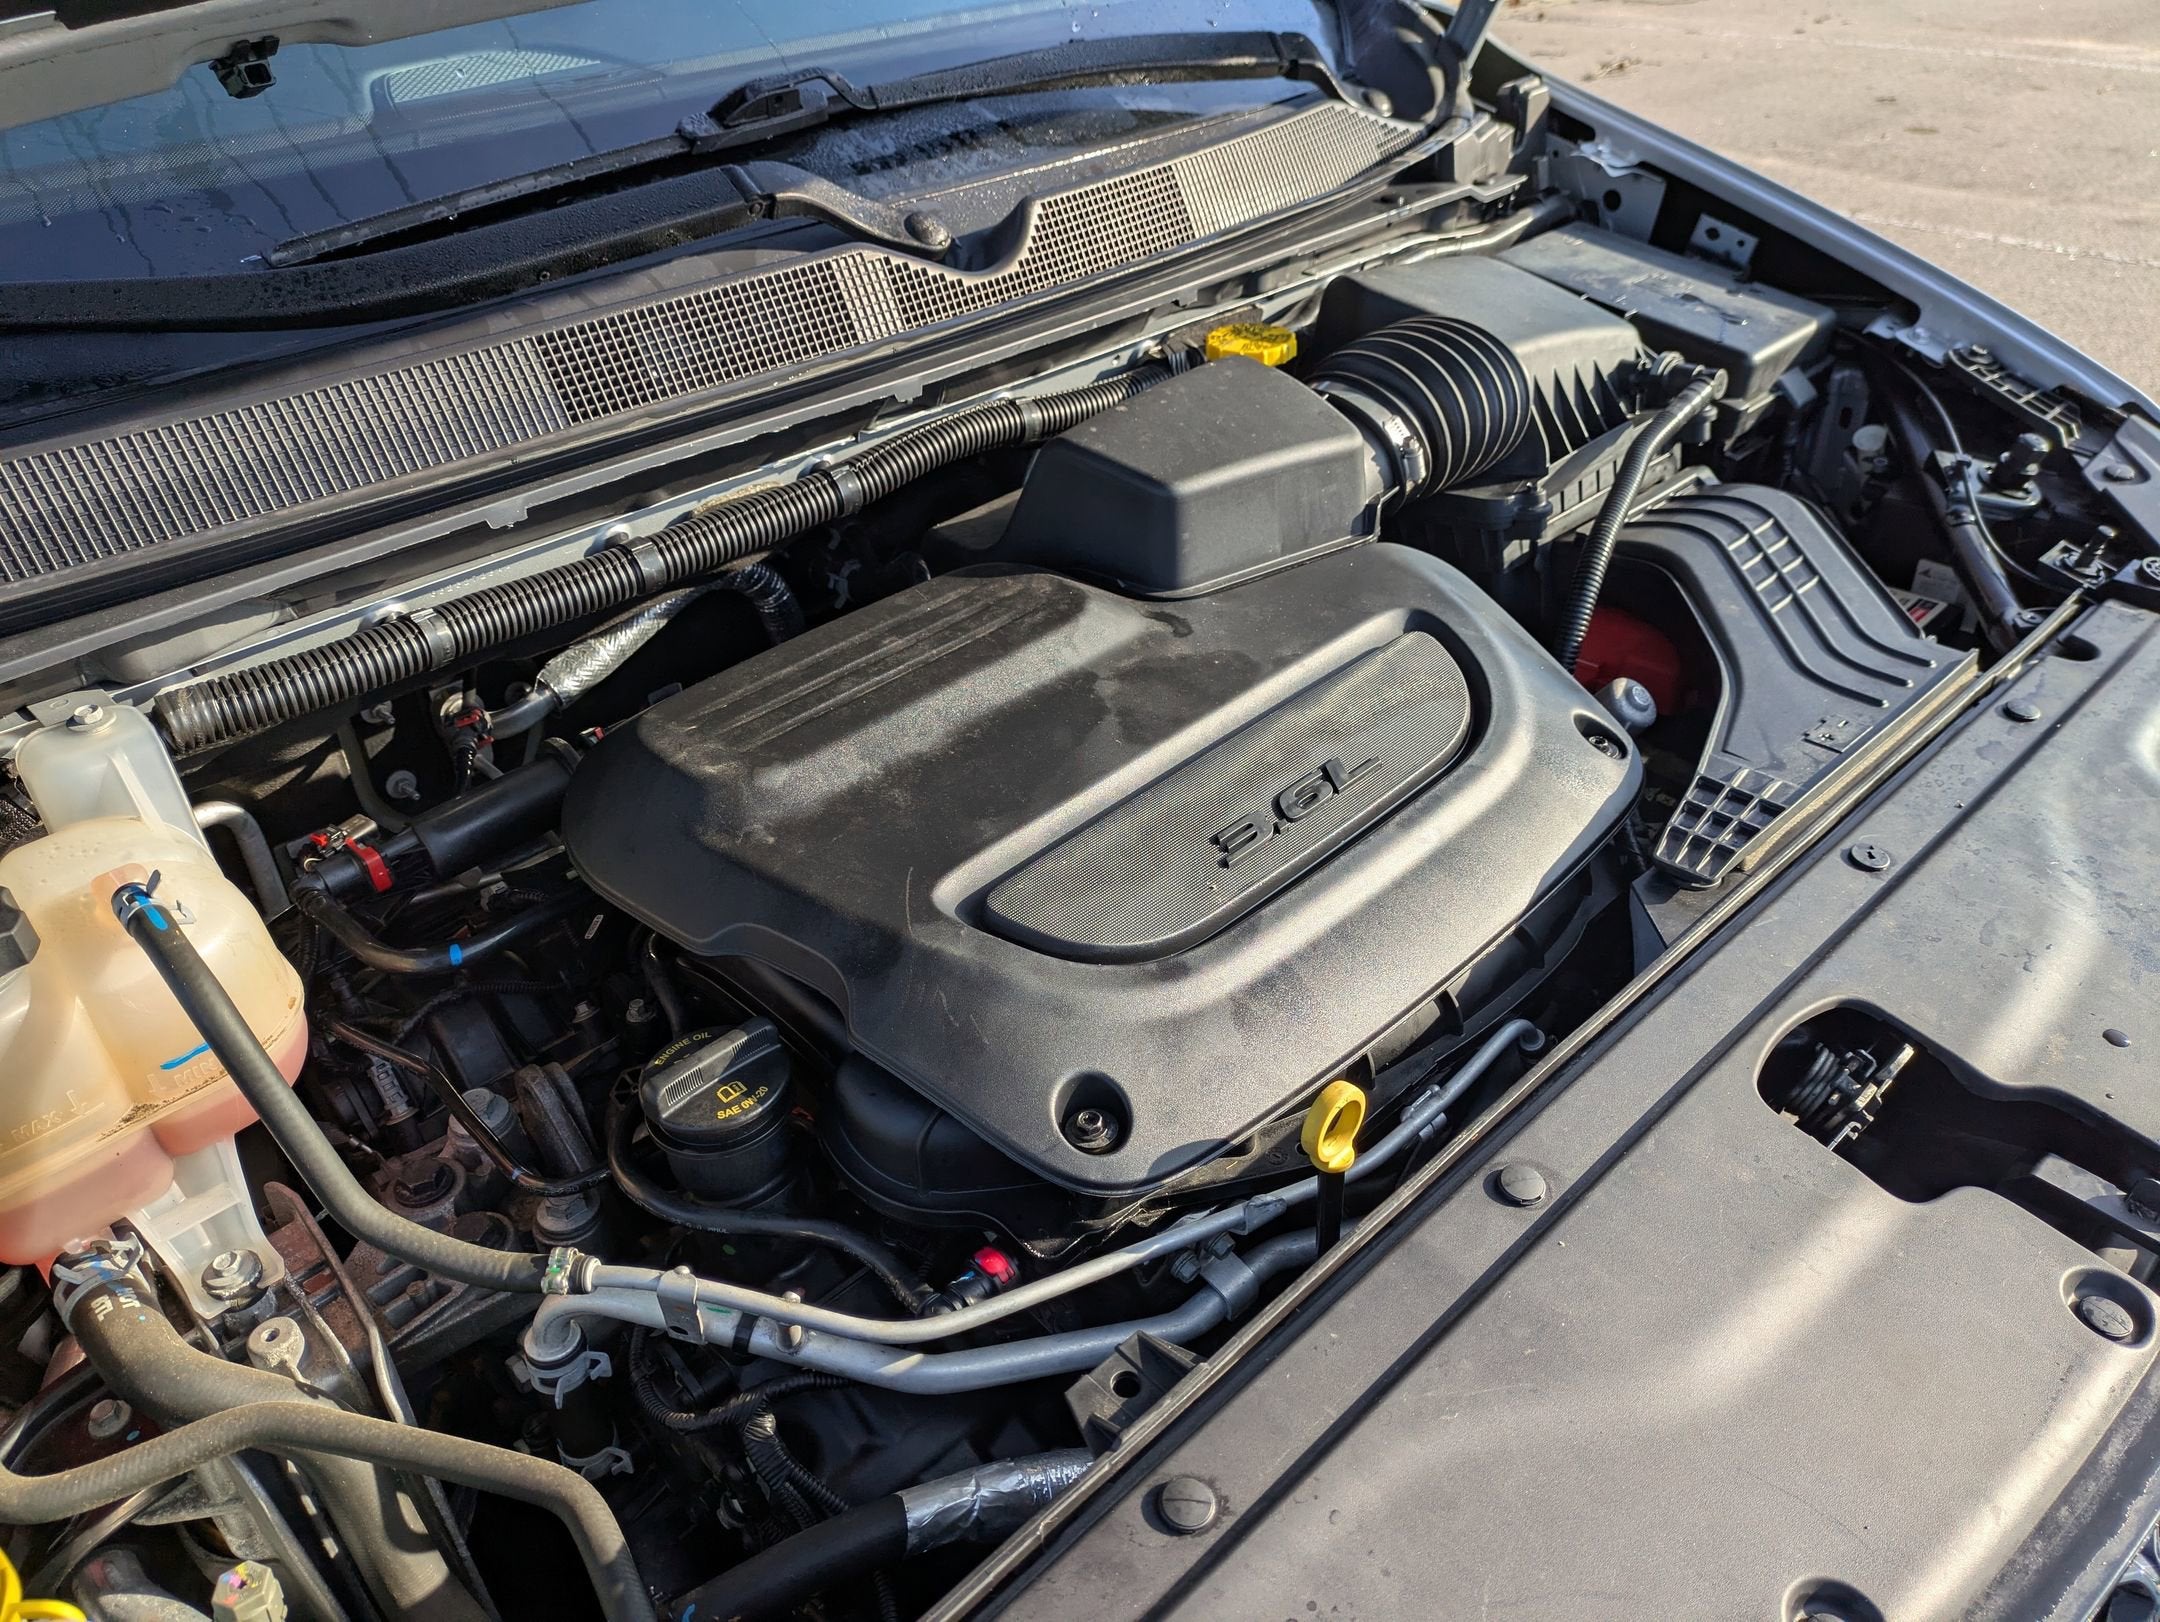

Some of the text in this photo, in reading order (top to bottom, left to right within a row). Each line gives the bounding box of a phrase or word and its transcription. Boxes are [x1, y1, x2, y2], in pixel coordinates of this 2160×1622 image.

[1211, 756, 1382, 869] 3.6L
[654, 1031, 713, 1066] ENGINE OIL
[174, 1057, 220, 1090] MIN
[717, 1086, 769, 1120] SAE 0W-20
